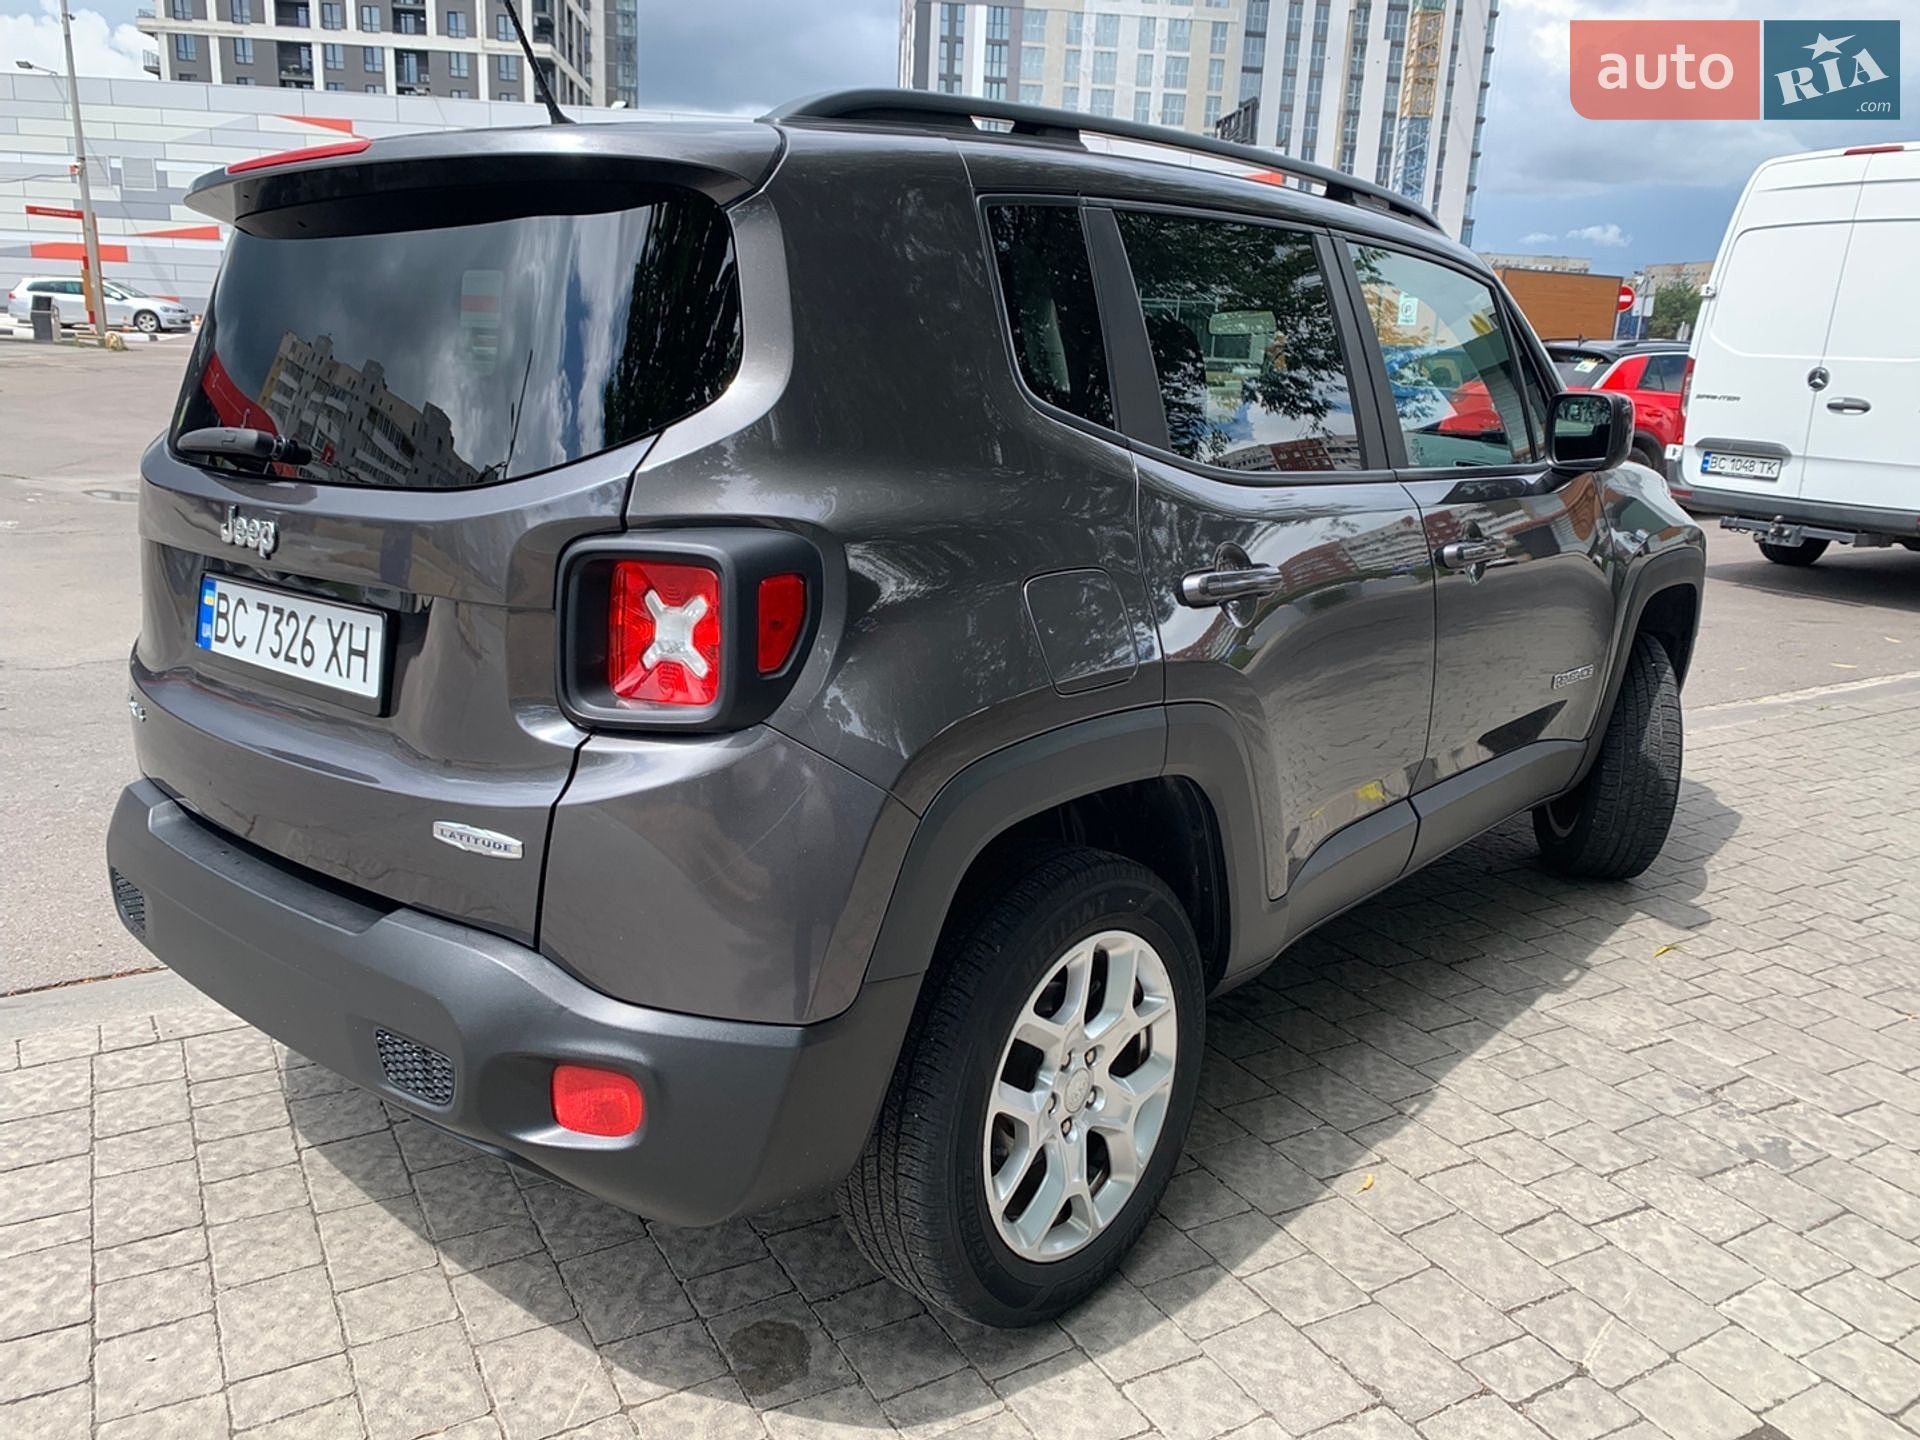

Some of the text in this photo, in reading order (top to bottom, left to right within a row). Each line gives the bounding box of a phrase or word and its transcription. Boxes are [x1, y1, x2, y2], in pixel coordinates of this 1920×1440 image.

[1710, 456, 1777, 475] BC 1048 TK
[220, 504, 278, 560] Jeep
[214, 591, 371, 683] BC 7326 XH
[440, 828, 513, 853] LATITUDE
